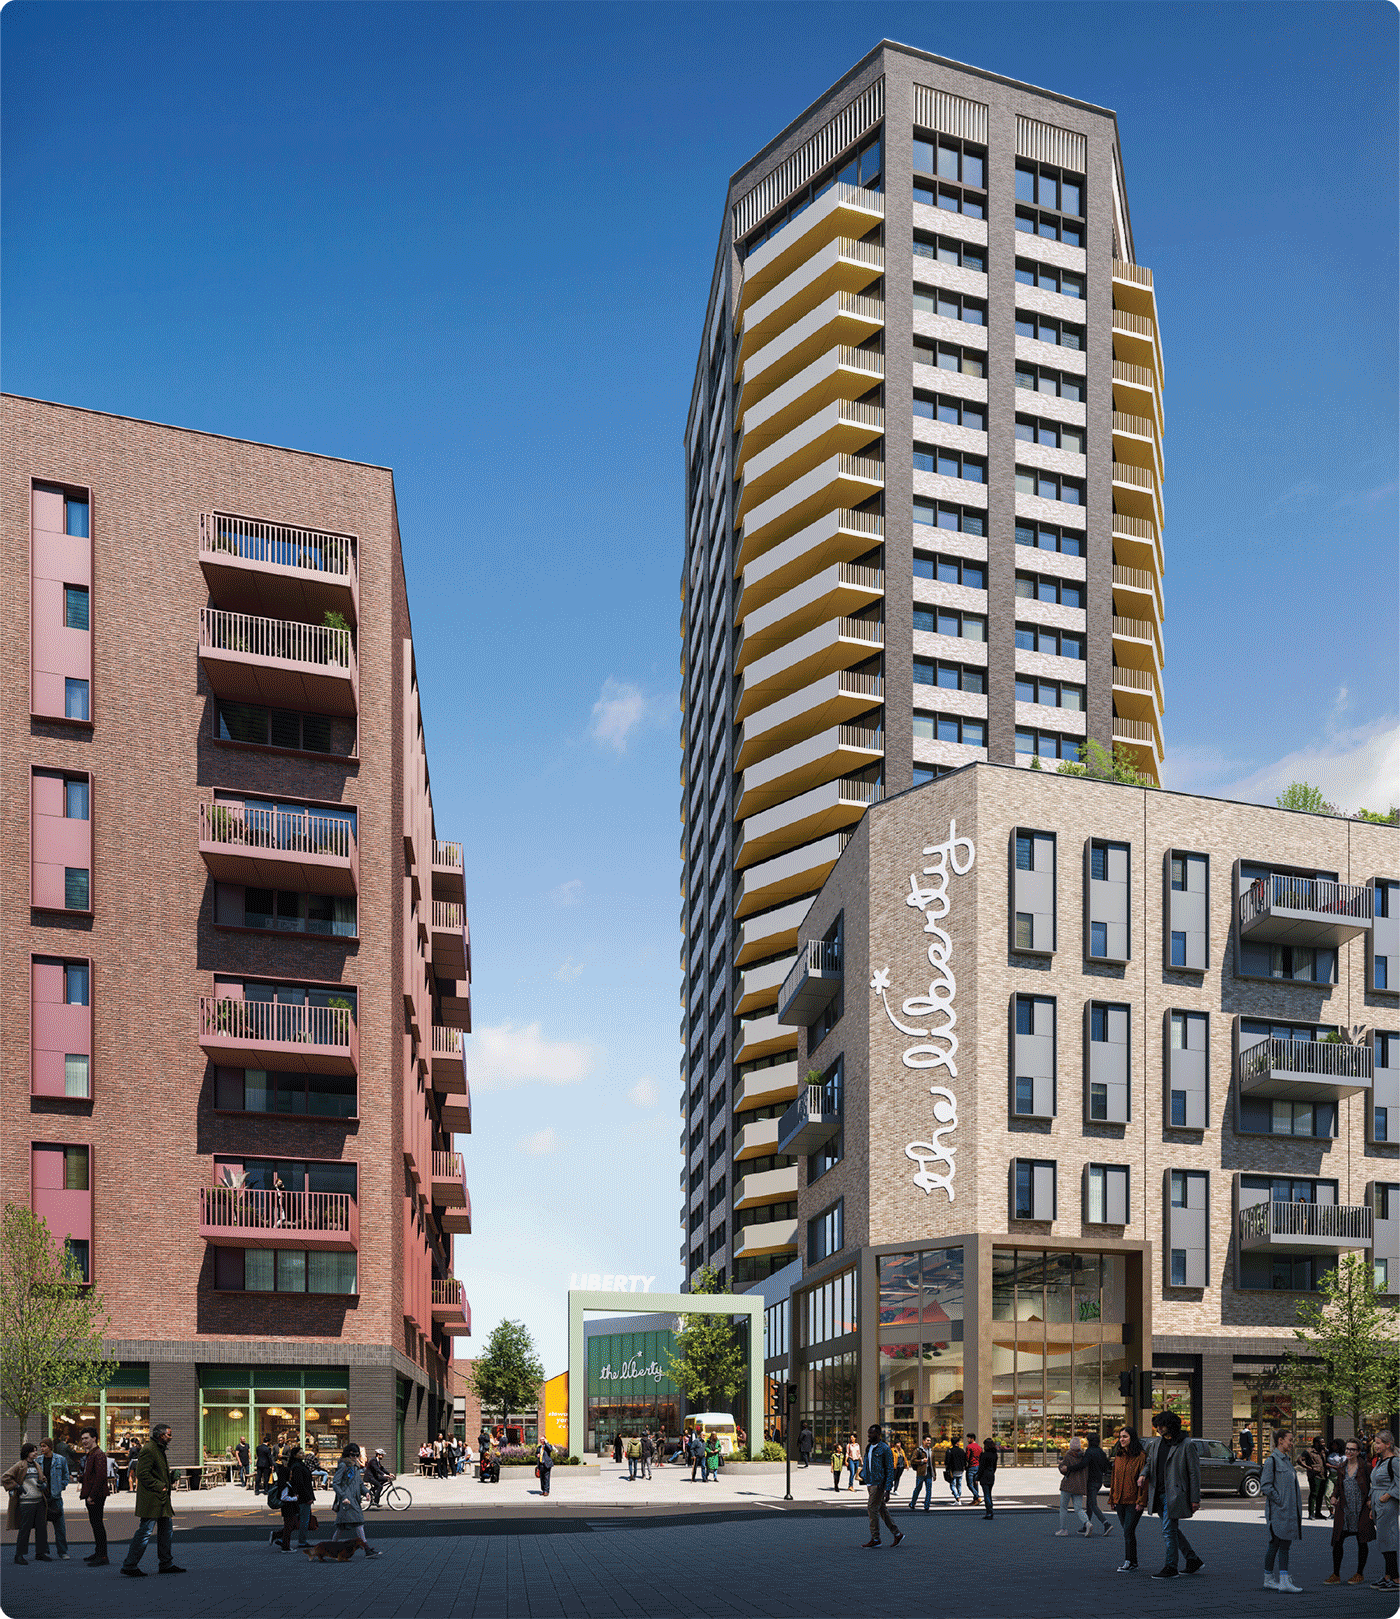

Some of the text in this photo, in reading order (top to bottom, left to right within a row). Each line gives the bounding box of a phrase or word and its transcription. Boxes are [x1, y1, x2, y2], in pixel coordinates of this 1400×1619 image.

[870, 818, 976, 1203] the liberty
[569, 1272, 656, 1293] LIBERTY
[599, 1350, 665, 1383] the liberty
